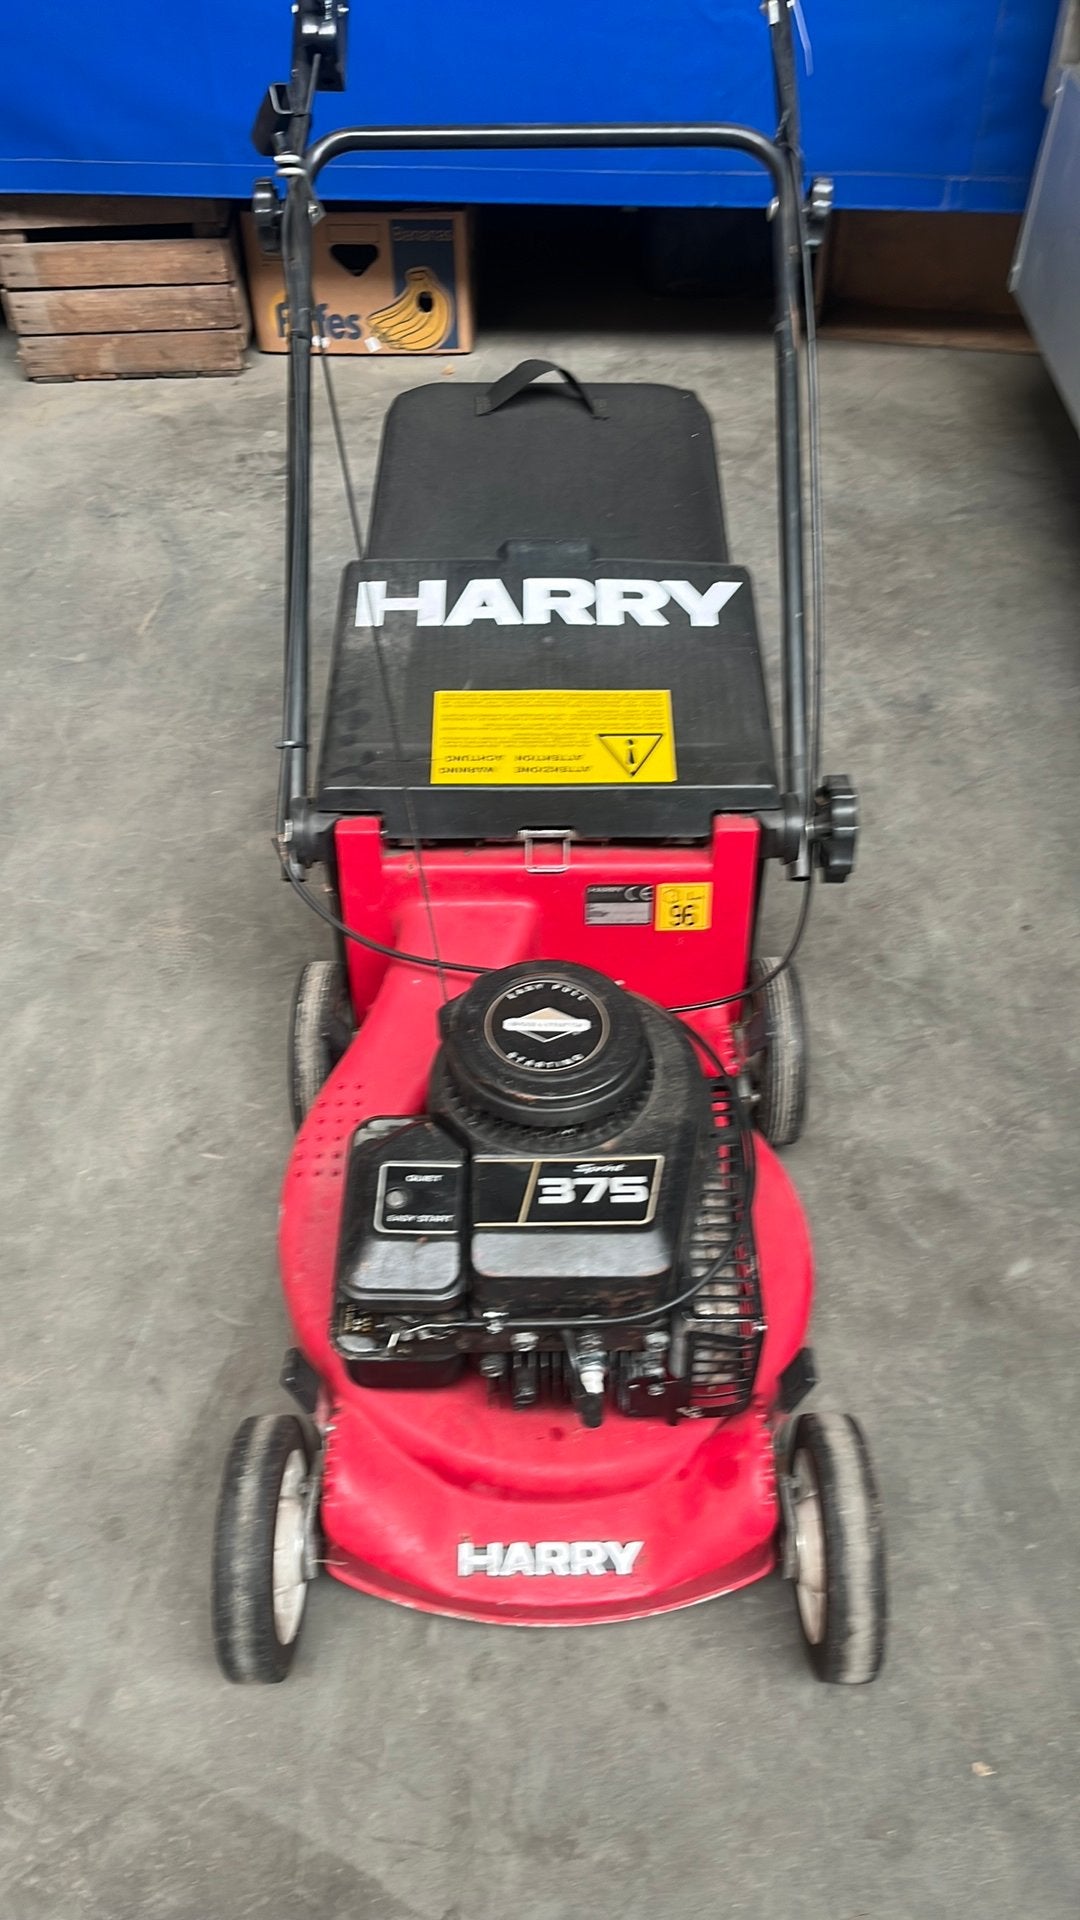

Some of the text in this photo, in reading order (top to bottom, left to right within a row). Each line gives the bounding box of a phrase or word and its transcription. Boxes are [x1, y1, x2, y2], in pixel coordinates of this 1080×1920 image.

[355, 578, 743, 627] HARRY
[438, 766, 496, 774] WARNING
[669, 904, 698, 927] 96
[506, 983, 589, 1001] EASY PULL
[505, 1051, 585, 1069] STARTING
[572, 1163, 629, 1174] Sprint
[537, 1175, 649, 1205] 375
[385, 1214, 456, 1223] EASY START
[457, 1541, 645, 1577] HARRY
